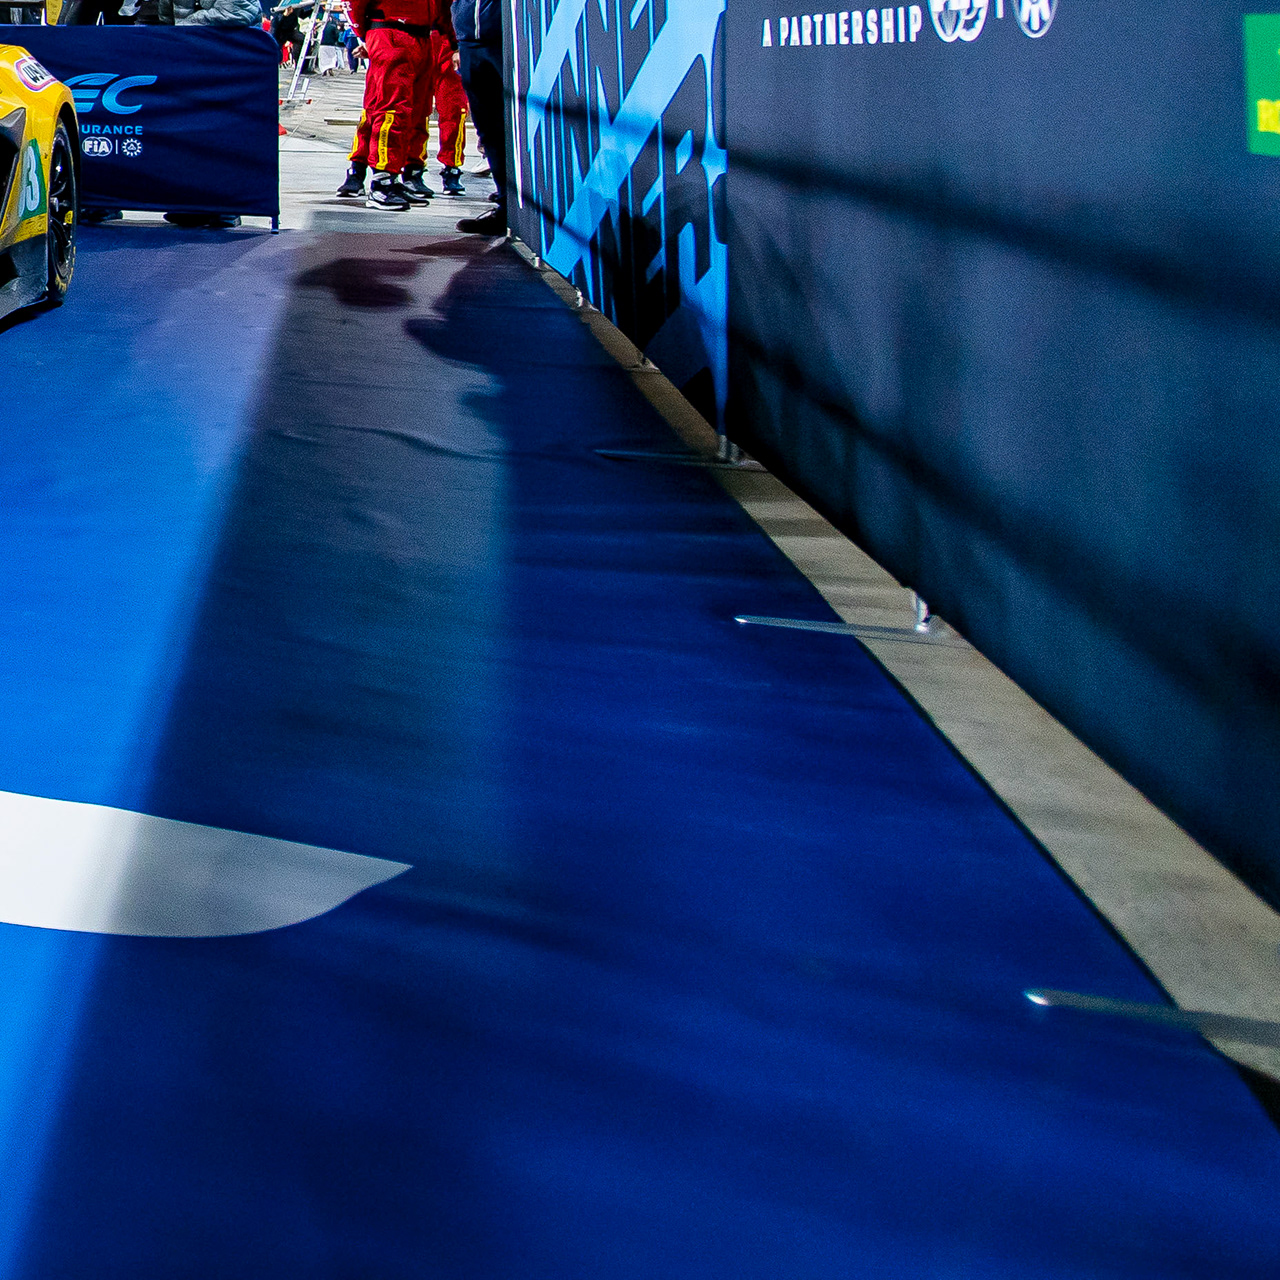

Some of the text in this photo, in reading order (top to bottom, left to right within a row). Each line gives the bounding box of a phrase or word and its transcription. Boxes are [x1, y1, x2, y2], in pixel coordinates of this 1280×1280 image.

[762, 6, 922, 46] A PARTNERSHIP
[64, 73, 158, 115] EC
[81, 124, 143, 135] URANCE
